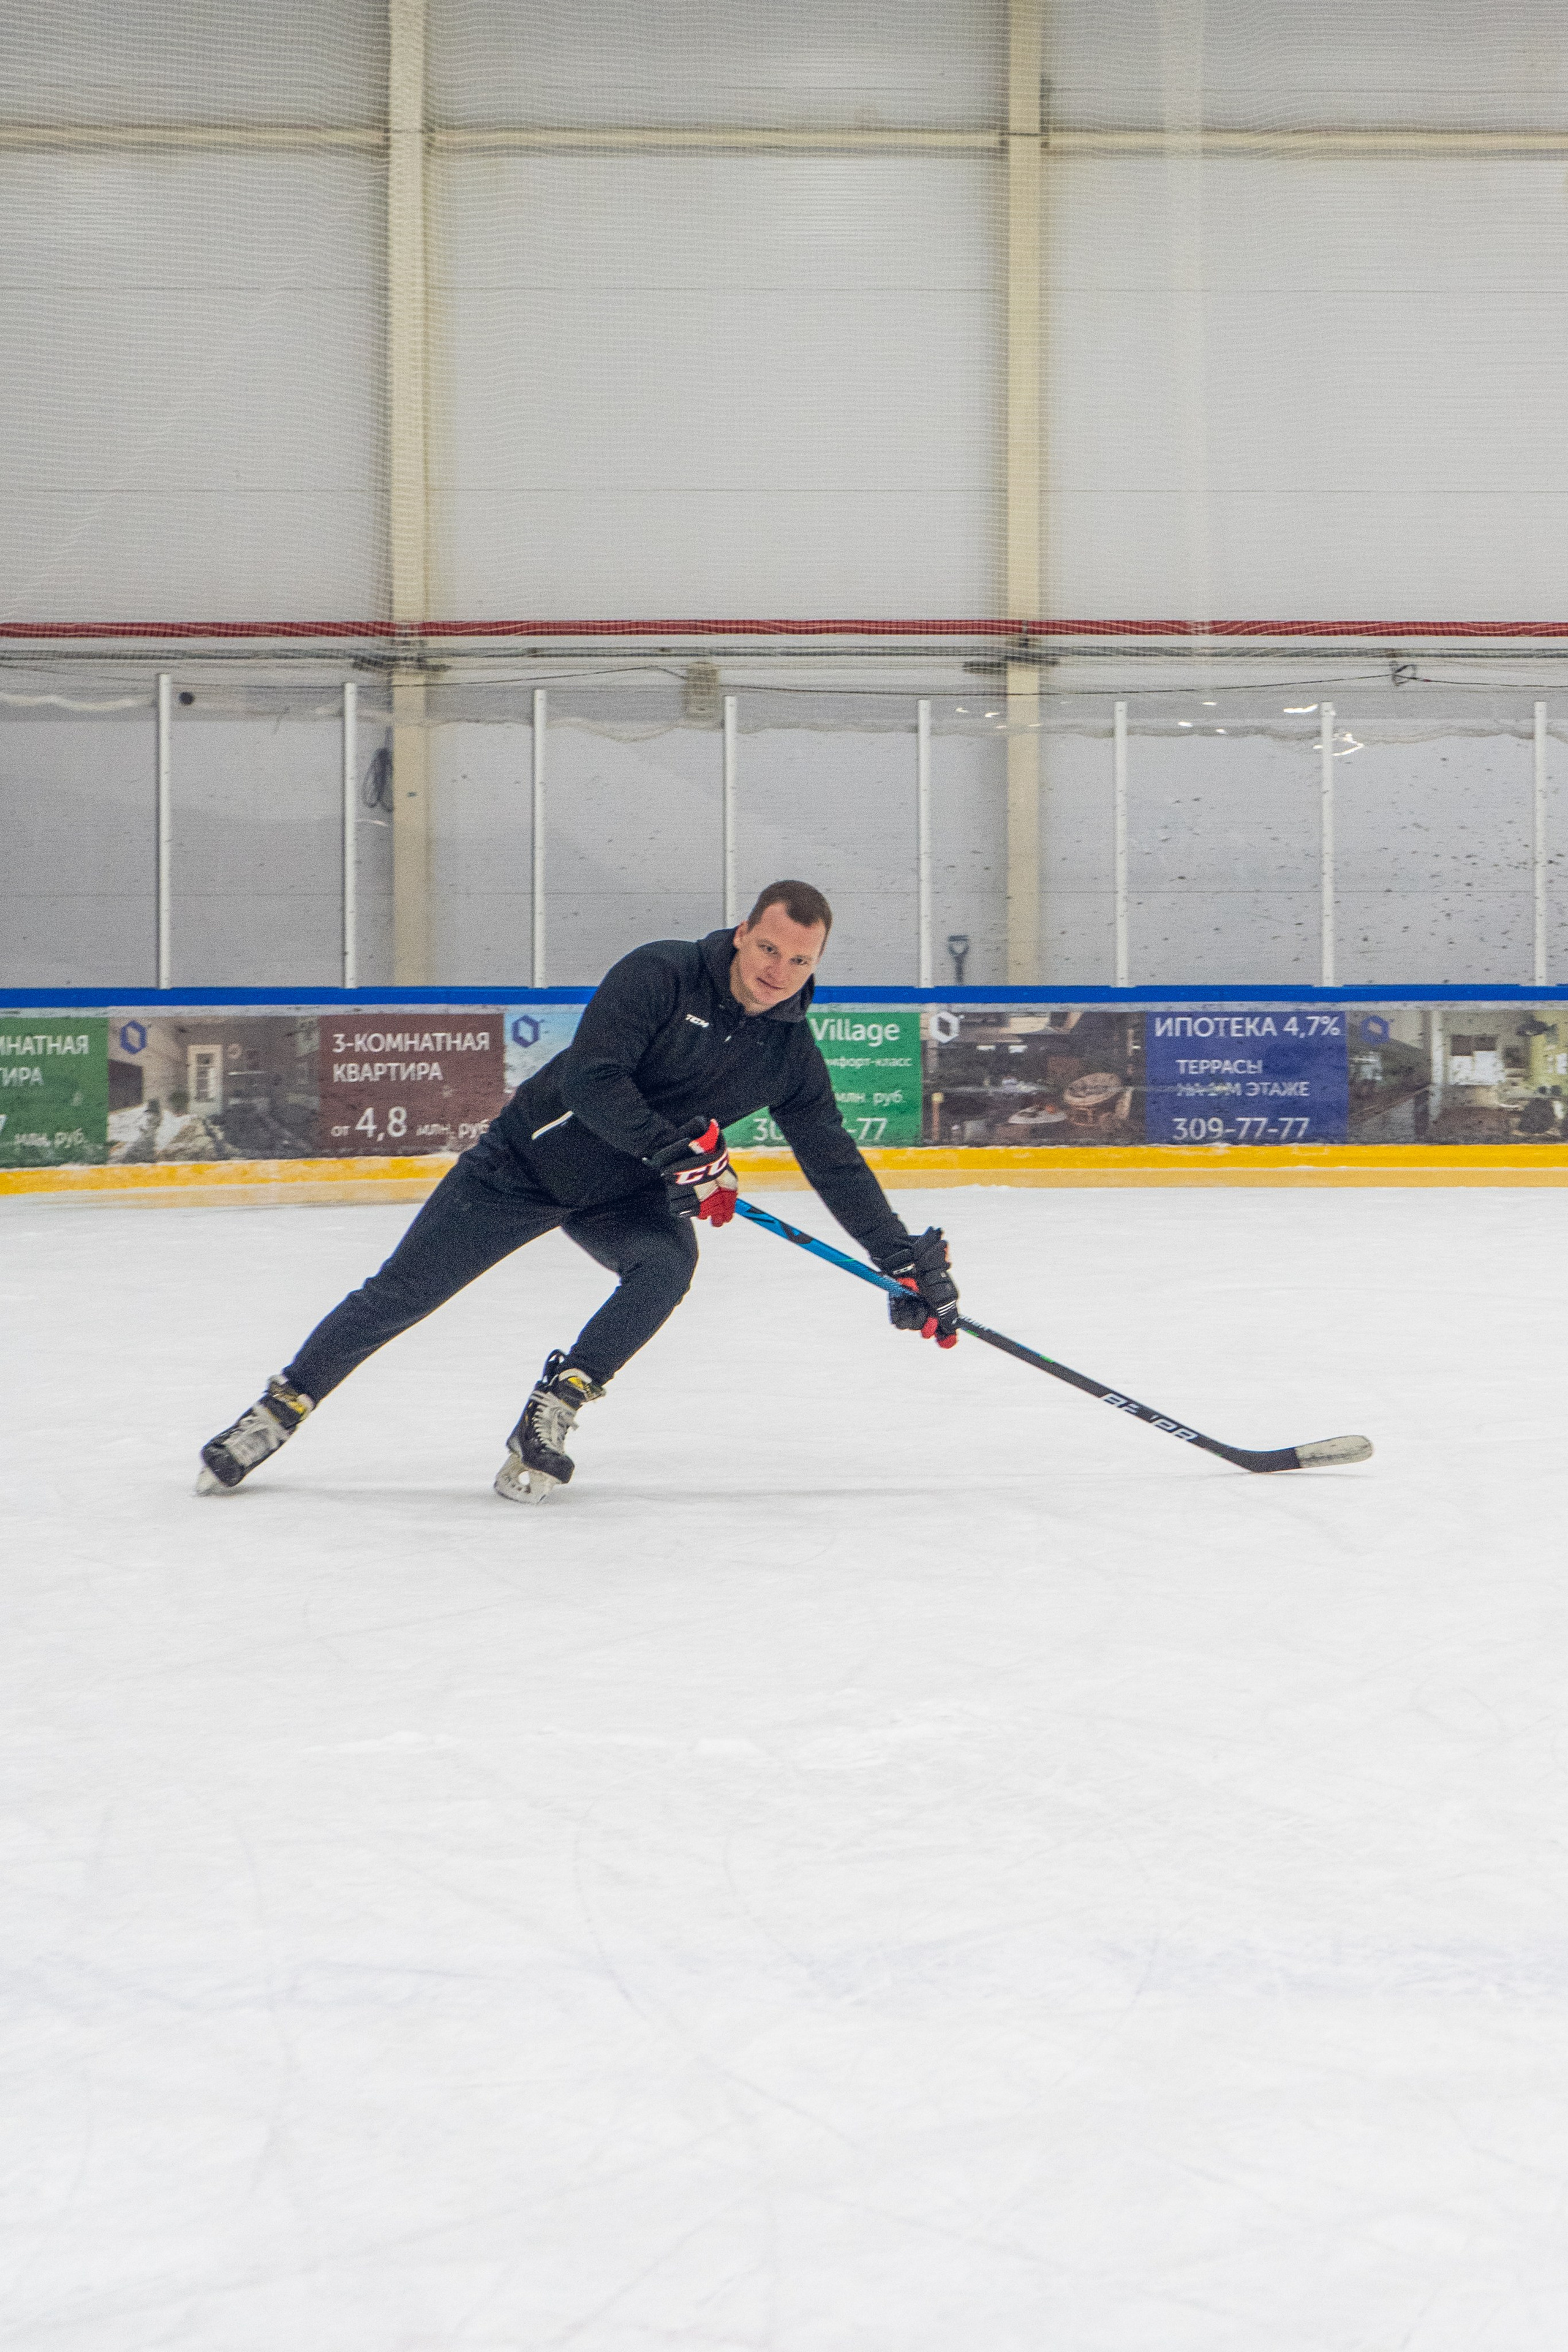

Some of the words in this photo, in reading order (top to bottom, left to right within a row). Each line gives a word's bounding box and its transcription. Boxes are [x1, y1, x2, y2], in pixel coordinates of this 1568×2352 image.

[810, 1017, 900, 1047] Village
[1155, 1017, 1277, 1037] ИПОТЕКА
[1283, 1016, 1340, 1038] 4,7%
[0, 1035, 89, 1055] НАТНАЯ
[332, 1032, 490, 1053] 3-КОМНАТНАЯ
[0, 1066, 44, 1087] ИРА
[333, 1063, 444, 1082] КВАРТИРА
[1175, 1060, 1263, 1074] ТЕРРАСЫ
[1246, 1082, 1310, 1096] ЭТАЖЕ
[331, 1125, 351, 1137] от
[355, 1106, 408, 1142] 4,8
[1172, 1117, 1310, 1140] 309-77-77
